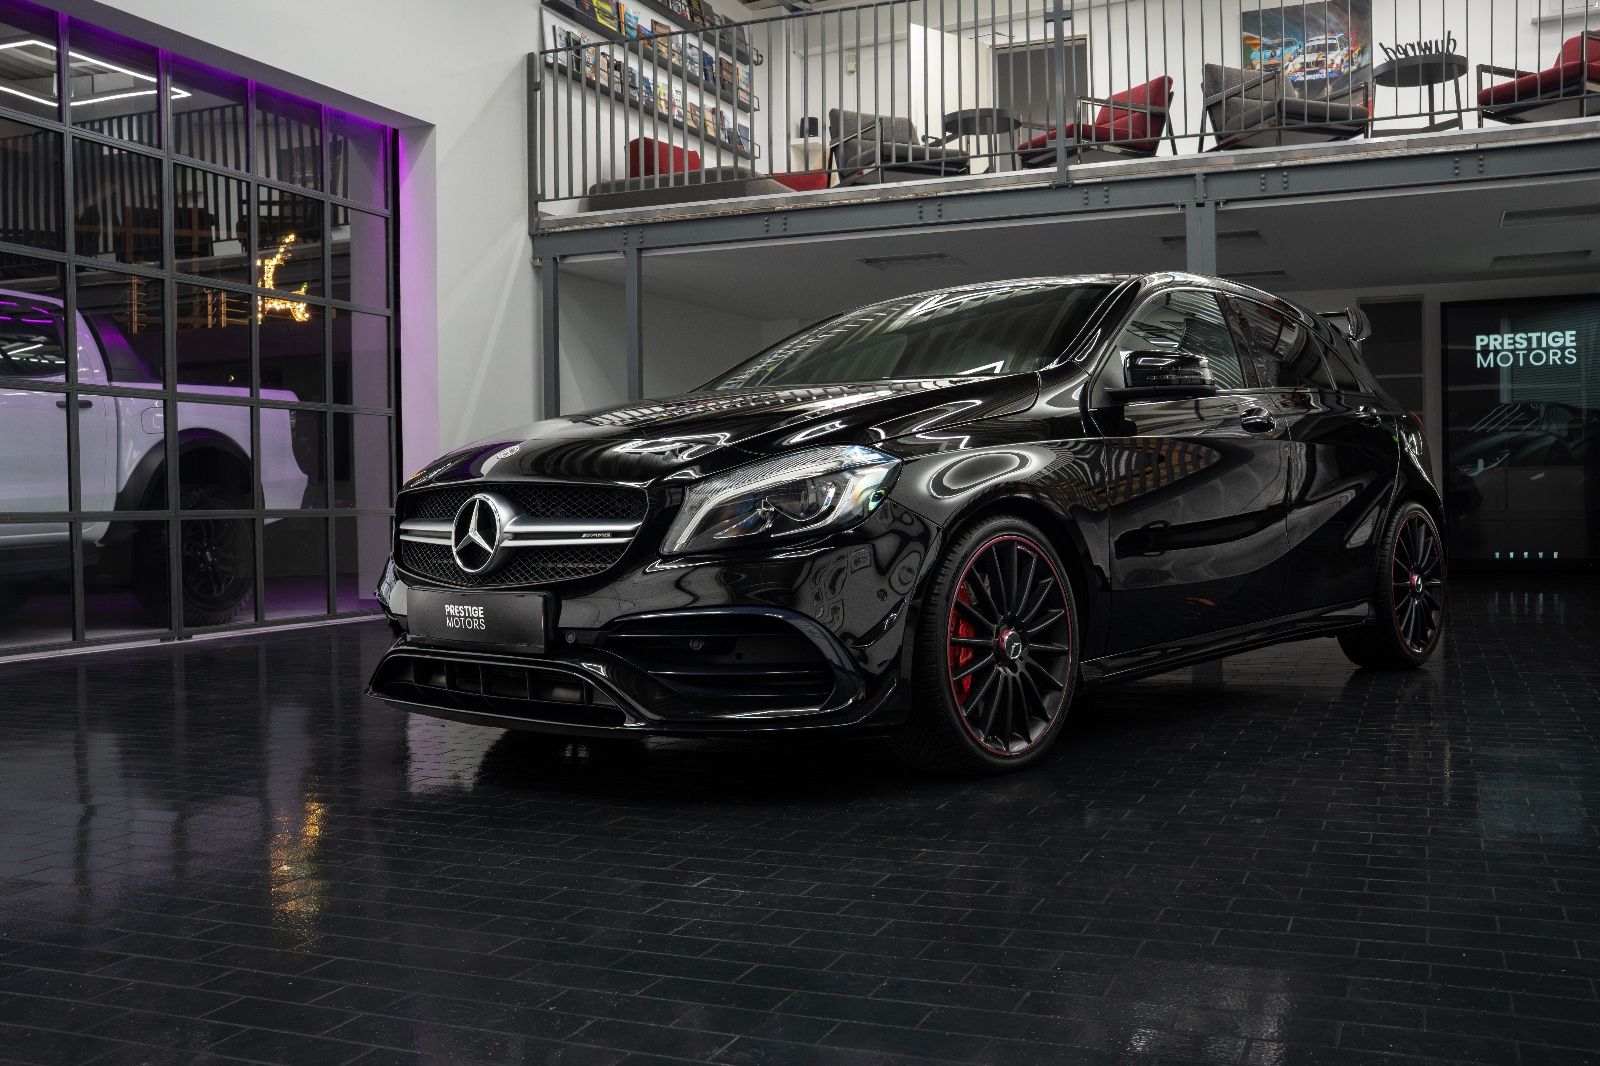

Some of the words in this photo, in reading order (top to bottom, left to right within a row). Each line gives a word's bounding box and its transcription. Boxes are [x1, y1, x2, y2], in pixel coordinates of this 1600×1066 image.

[1476, 331, 1577, 350] PRESTIGE
[1476, 348, 1577, 368] MOTORS
[445, 605, 484, 617] PRESTIGE
[446, 617, 486, 629] MOTORS
